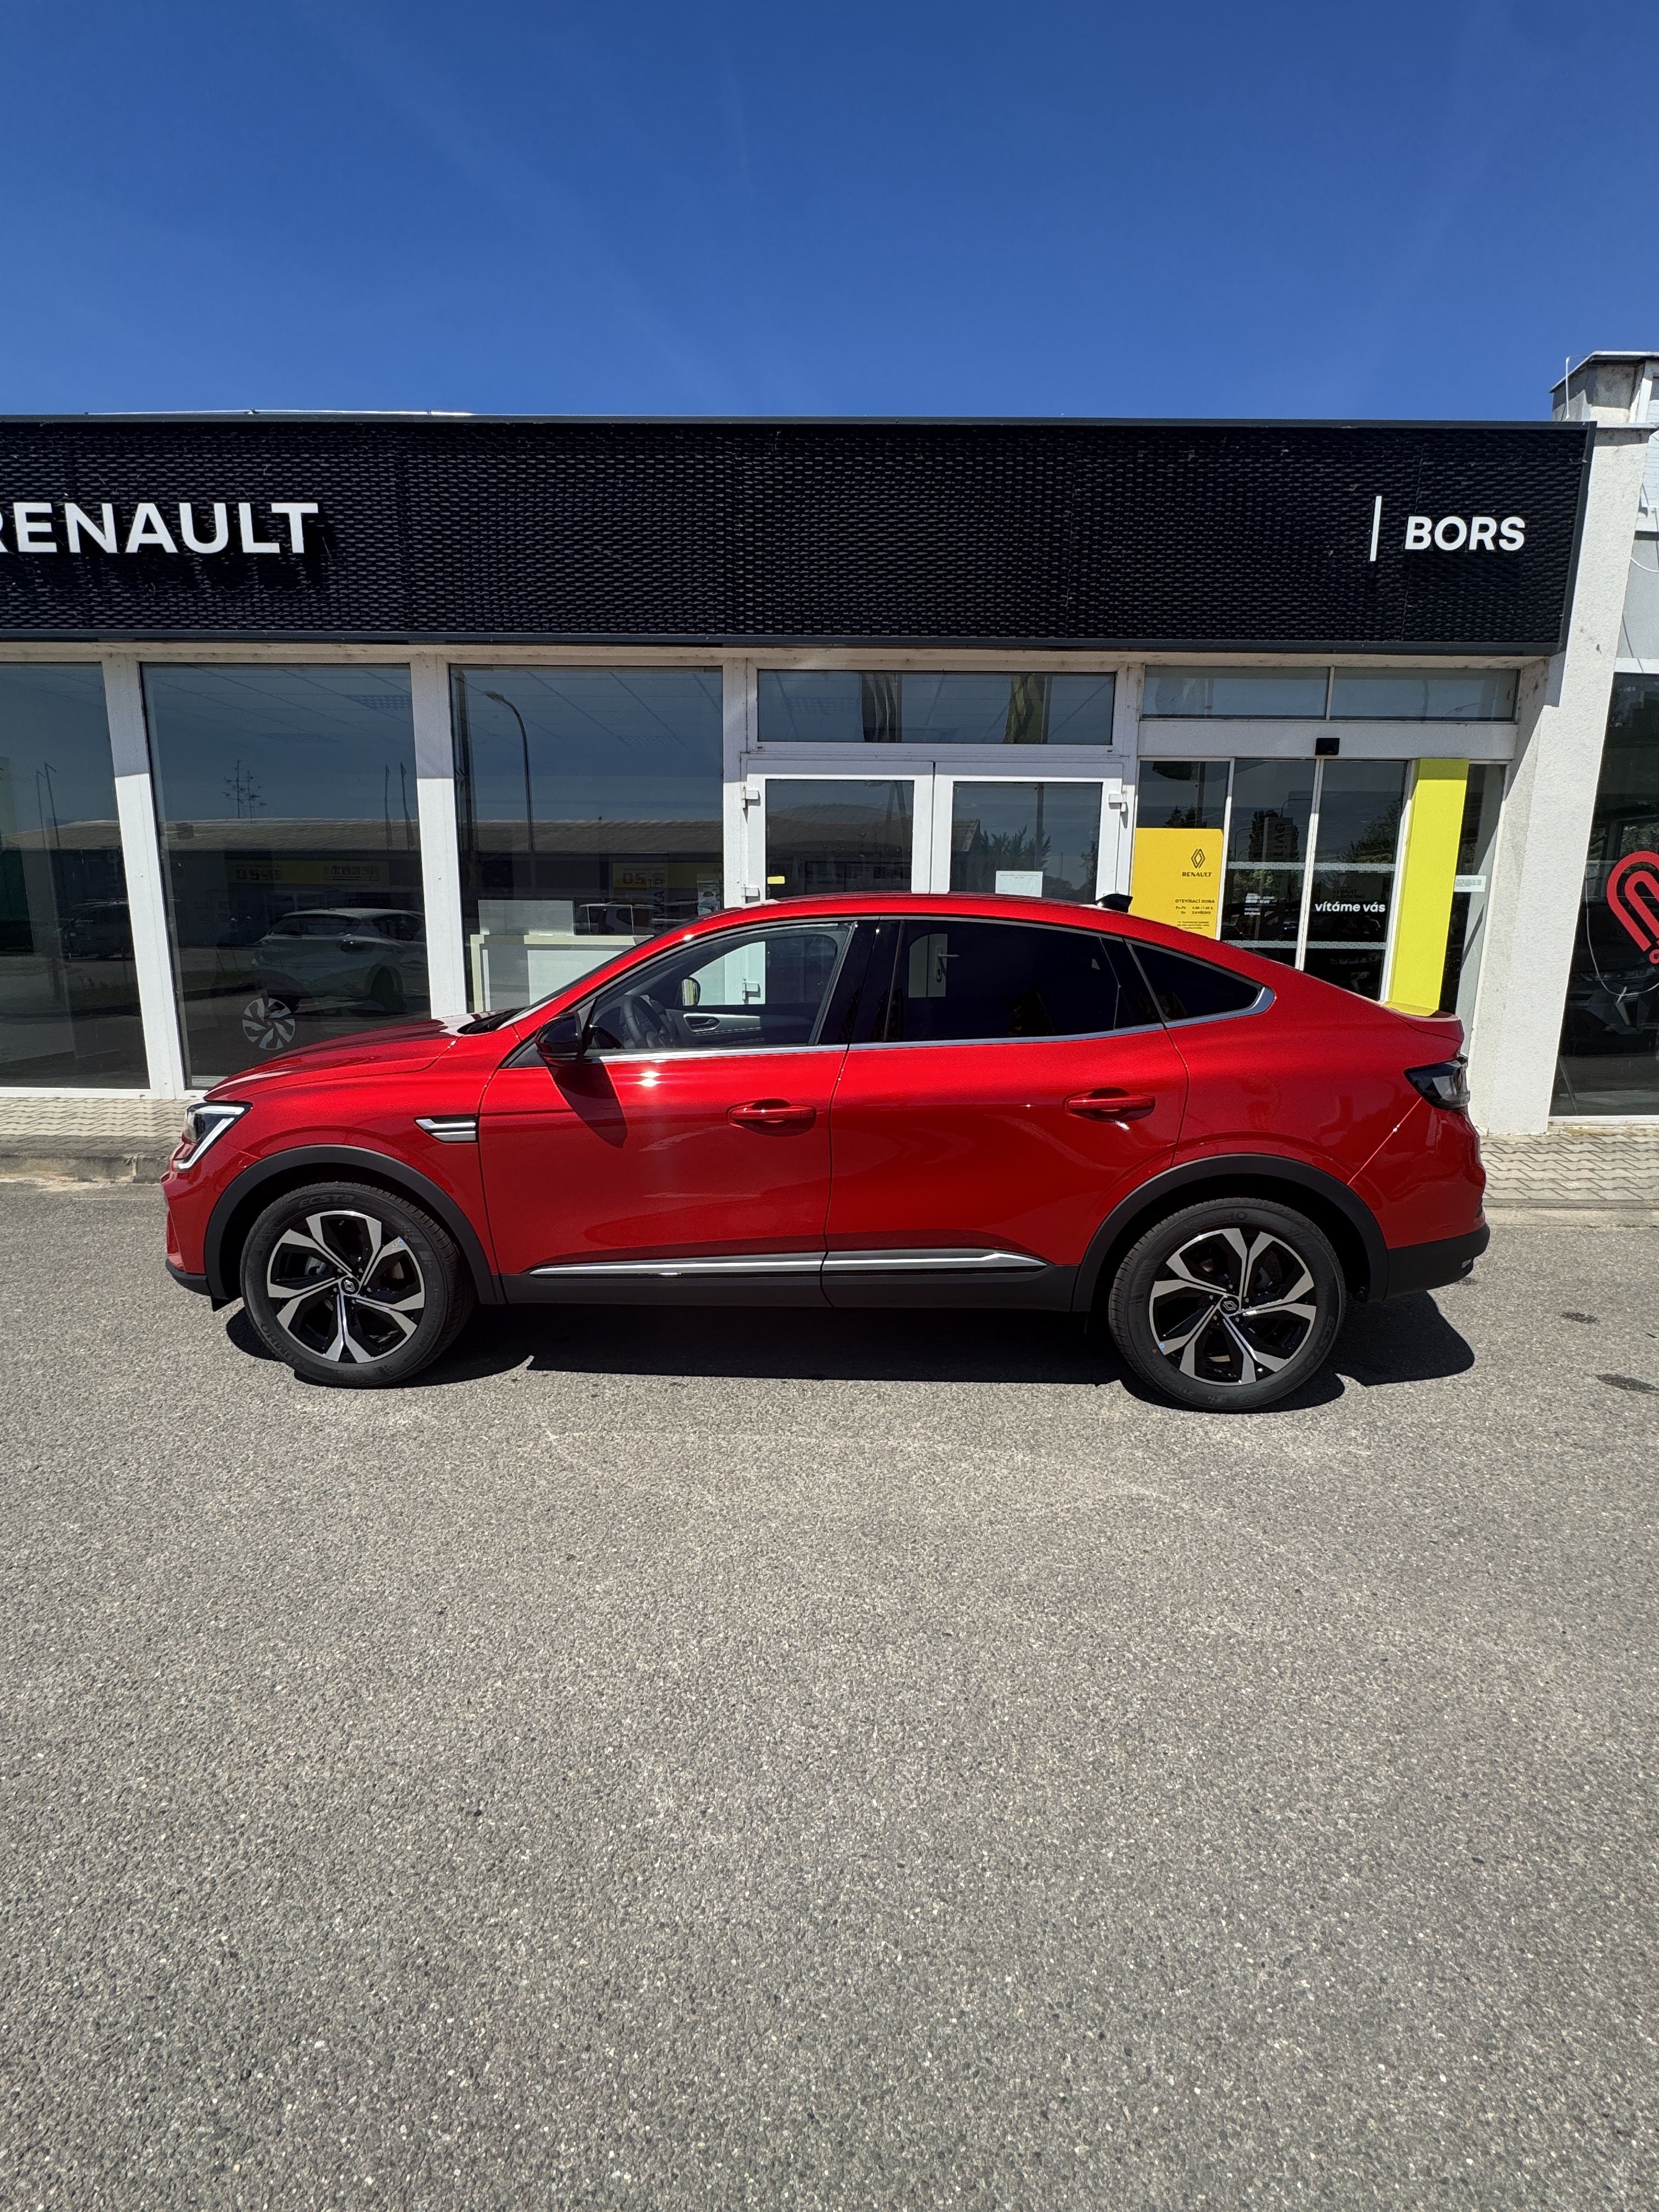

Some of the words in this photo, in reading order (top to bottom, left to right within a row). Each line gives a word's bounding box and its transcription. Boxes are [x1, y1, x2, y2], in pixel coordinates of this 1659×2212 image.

[0, 503, 318, 553] ENAULT
[1405, 516, 1525, 551] BORS
[1314, 901, 1361, 912] vítáme
[1362, 901, 1386, 912] vás
